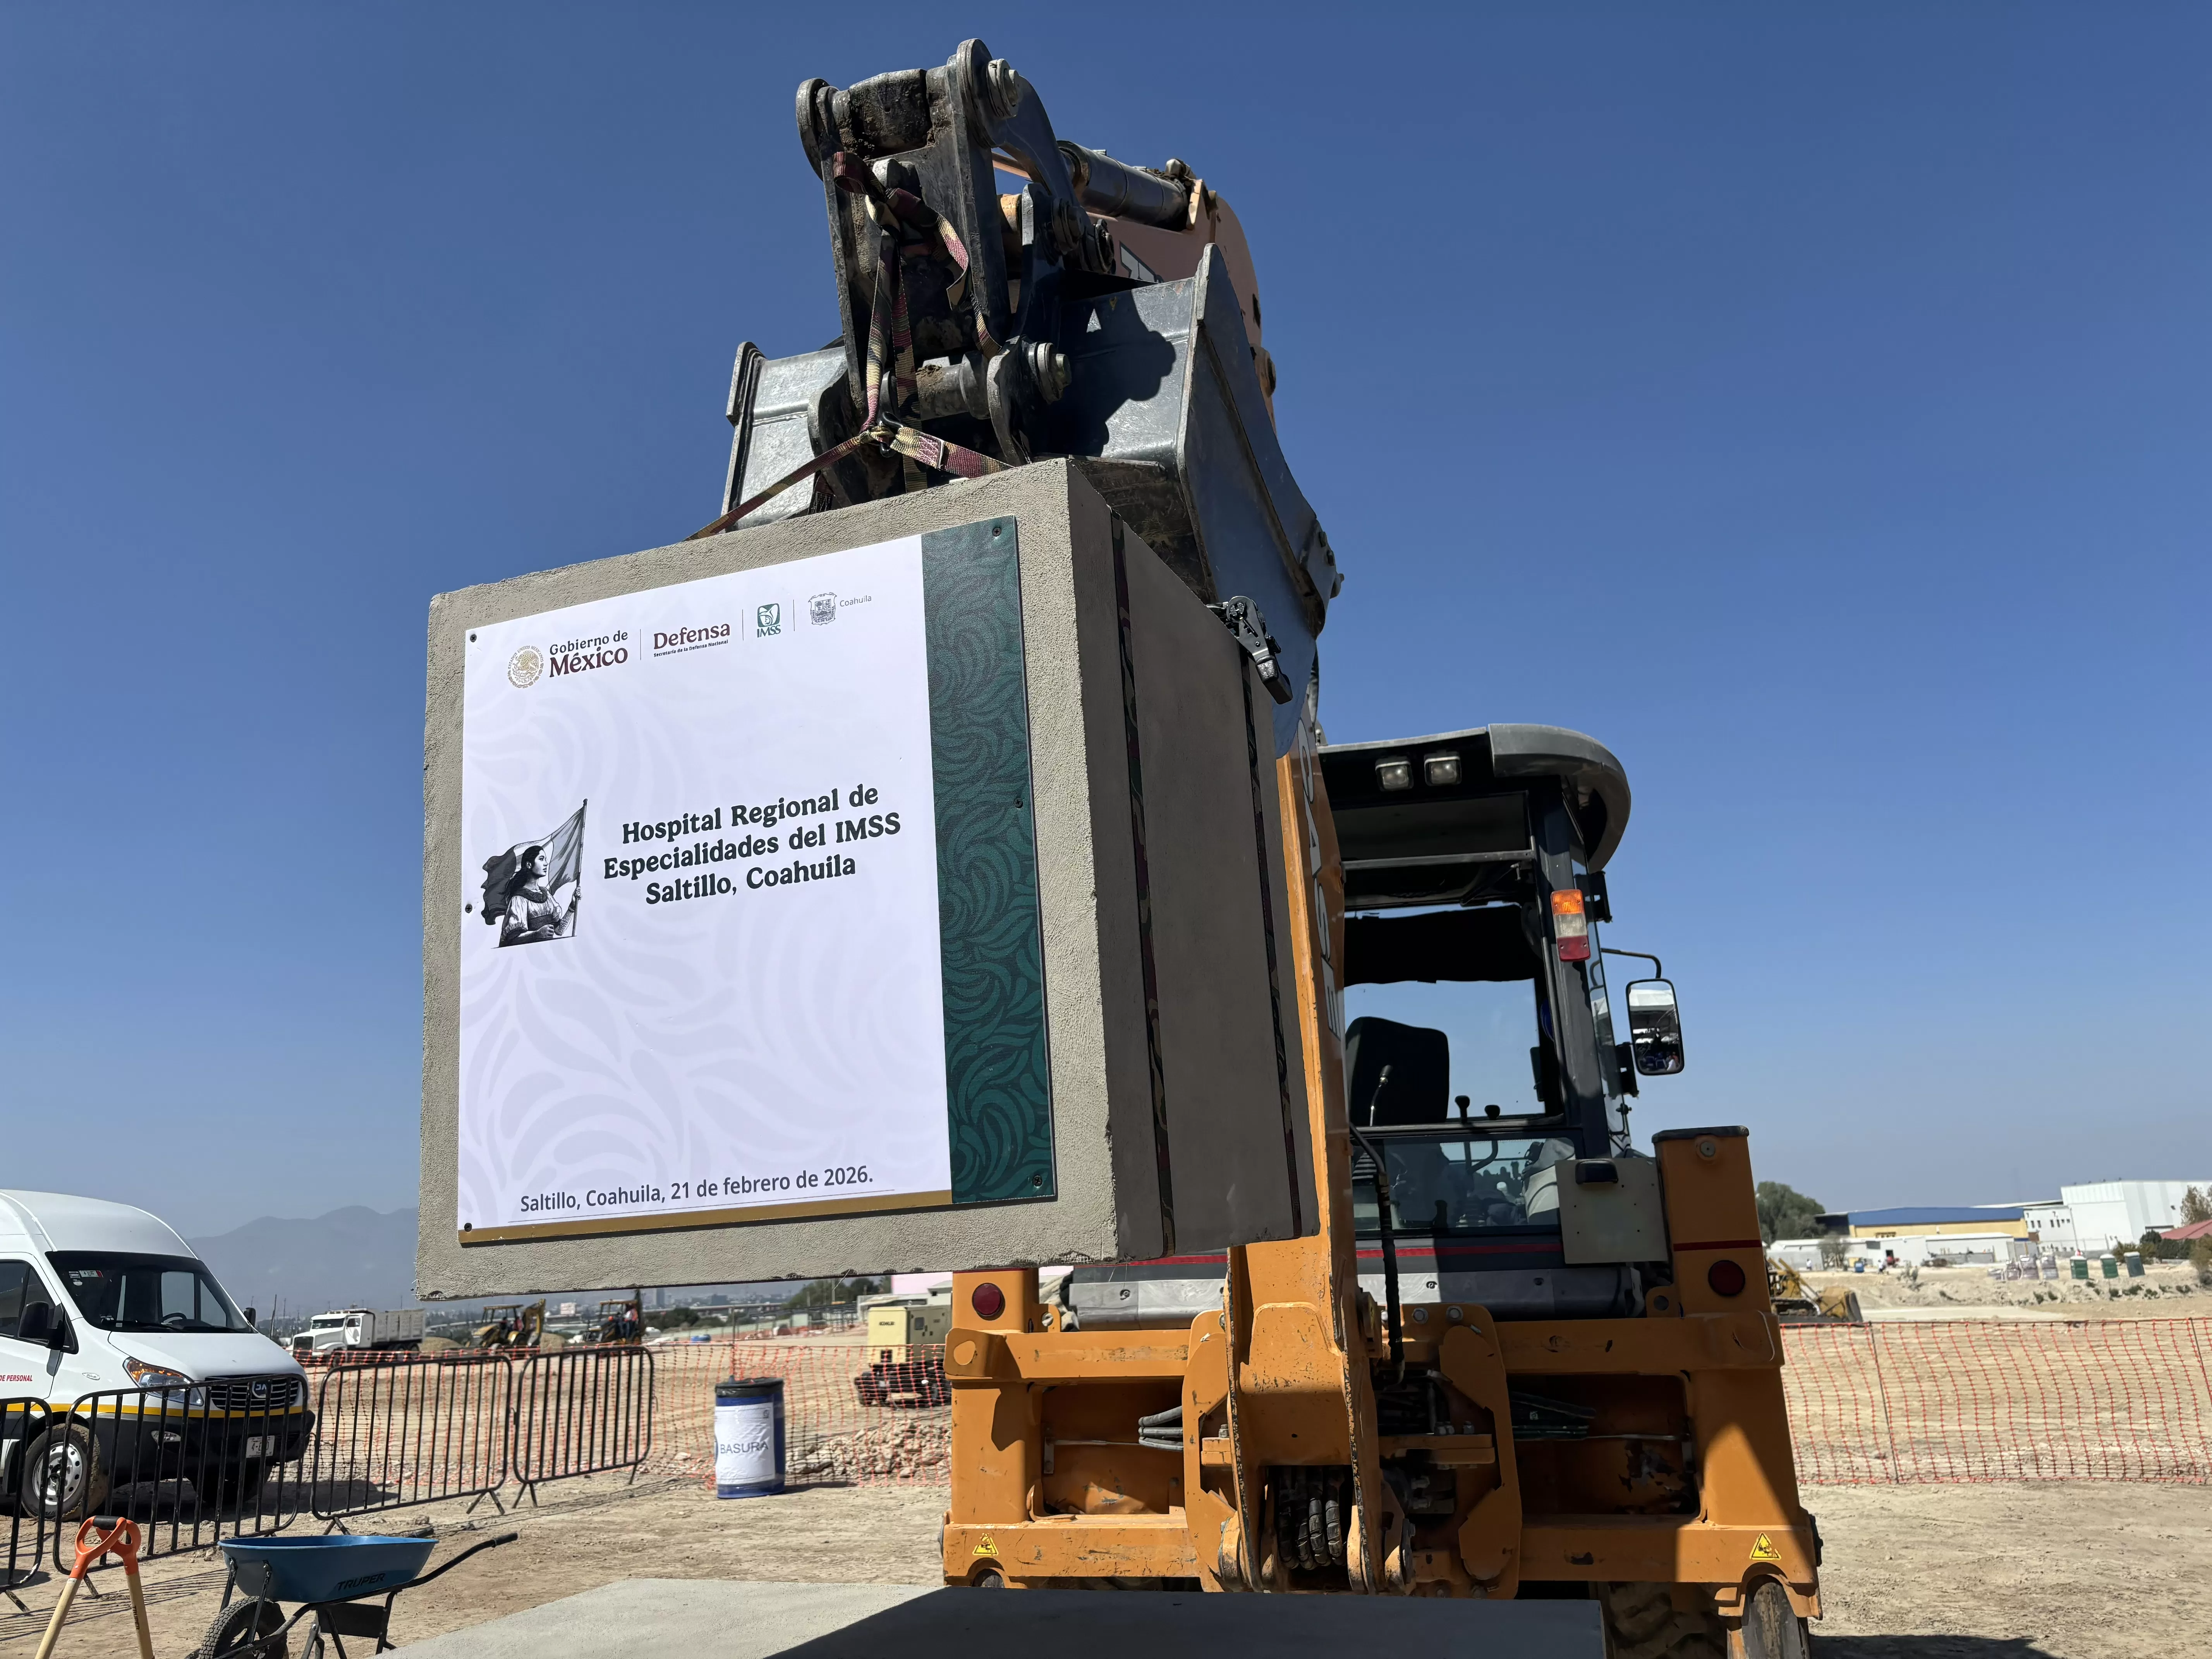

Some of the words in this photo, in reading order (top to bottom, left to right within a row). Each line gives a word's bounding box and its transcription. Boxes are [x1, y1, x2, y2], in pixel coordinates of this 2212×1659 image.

[840, 595, 872, 607] Coahuila
[550, 636, 610, 655] Gobierno
[613, 630, 628, 642] de
[653, 623, 730, 650] Defensa
[689, 643, 708, 651] Defensa
[708, 639, 728, 647] Nacional
[757, 625, 781, 638] IMSS
[549, 646, 628, 678] México
[623, 807, 722, 845] Hospital
[731, 788, 840, 827] Regional
[849, 783, 878, 807] de
[604, 834, 779, 879] Especialidades
[788, 823, 826, 850] del
[835, 812, 901, 844] IMSS
[646, 873, 737, 905] Saltillo,
[746, 854, 856, 889] Coahuila
[1297, 717, 1341, 1042] CASE
[520, 1191, 580, 1212] Saltillo,
[586, 1183, 665, 1207] Coahuila,
[671, 1181, 689, 1200] 21
[697, 1179, 718, 1197] de
[723, 1175, 790, 1195] febrero
[796, 1170, 818, 1188] de
[824, 1165, 873, 1186] 2026.
[720, 1441, 768, 1454] BASURA
[337, 1573, 386, 1591] TRUPER
